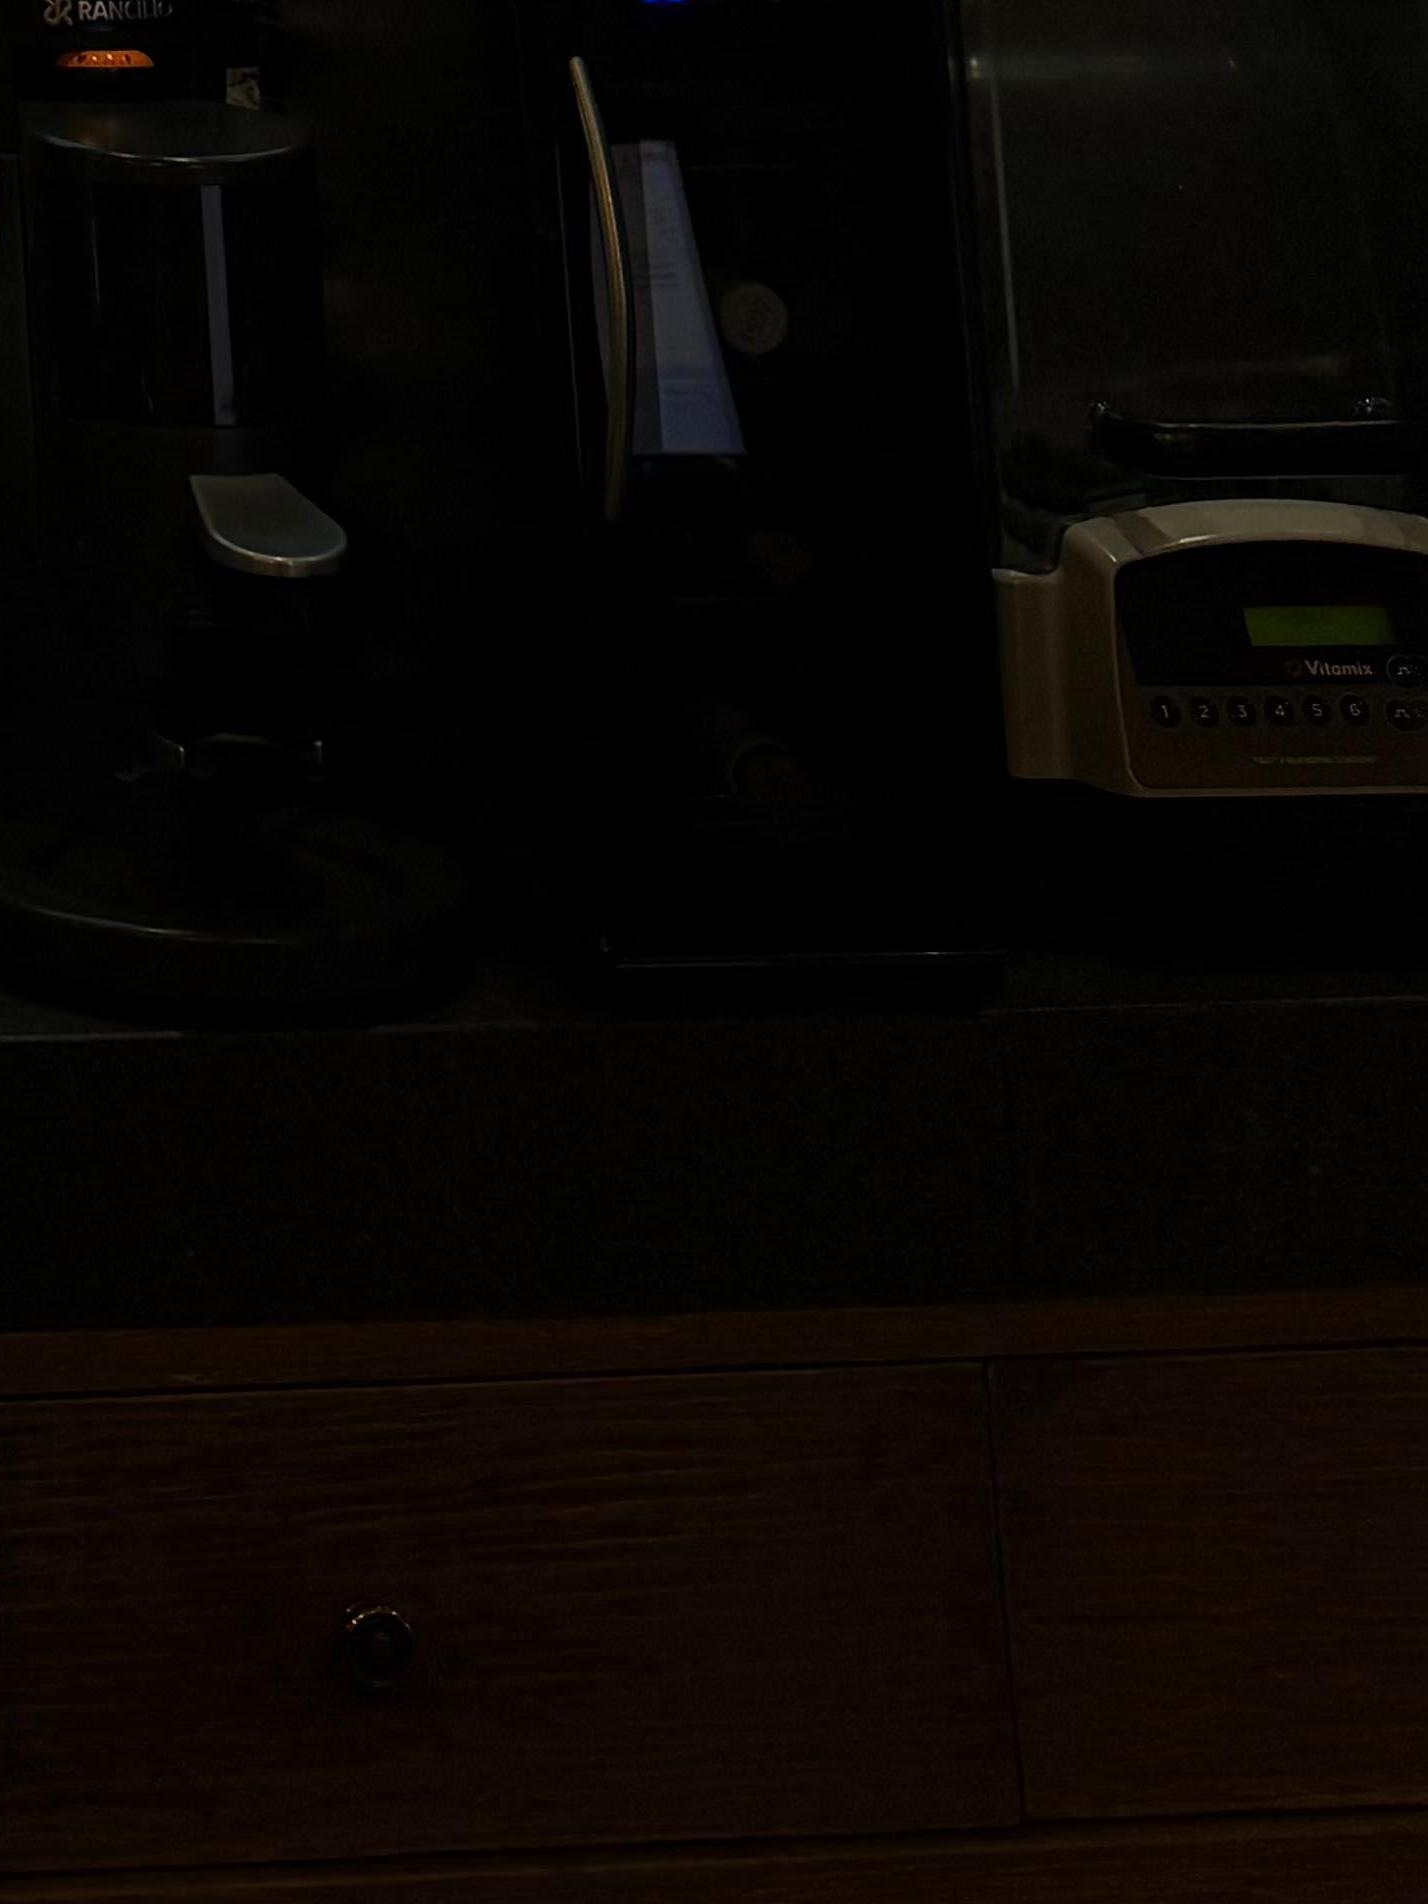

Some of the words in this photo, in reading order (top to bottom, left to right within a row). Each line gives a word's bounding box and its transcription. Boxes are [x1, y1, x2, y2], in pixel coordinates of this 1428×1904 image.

[77, 0, 175, 22] RANCILIO
[1303, 659, 1374, 676] Vitamix
[1198, 704, 1210, 719] 2
[1236, 704, 1249, 719] 3
[1274, 703, 1286, 718] 4
[1312, 703, 1323, 718] 5
[1349, 703, 1361, 717] 6
